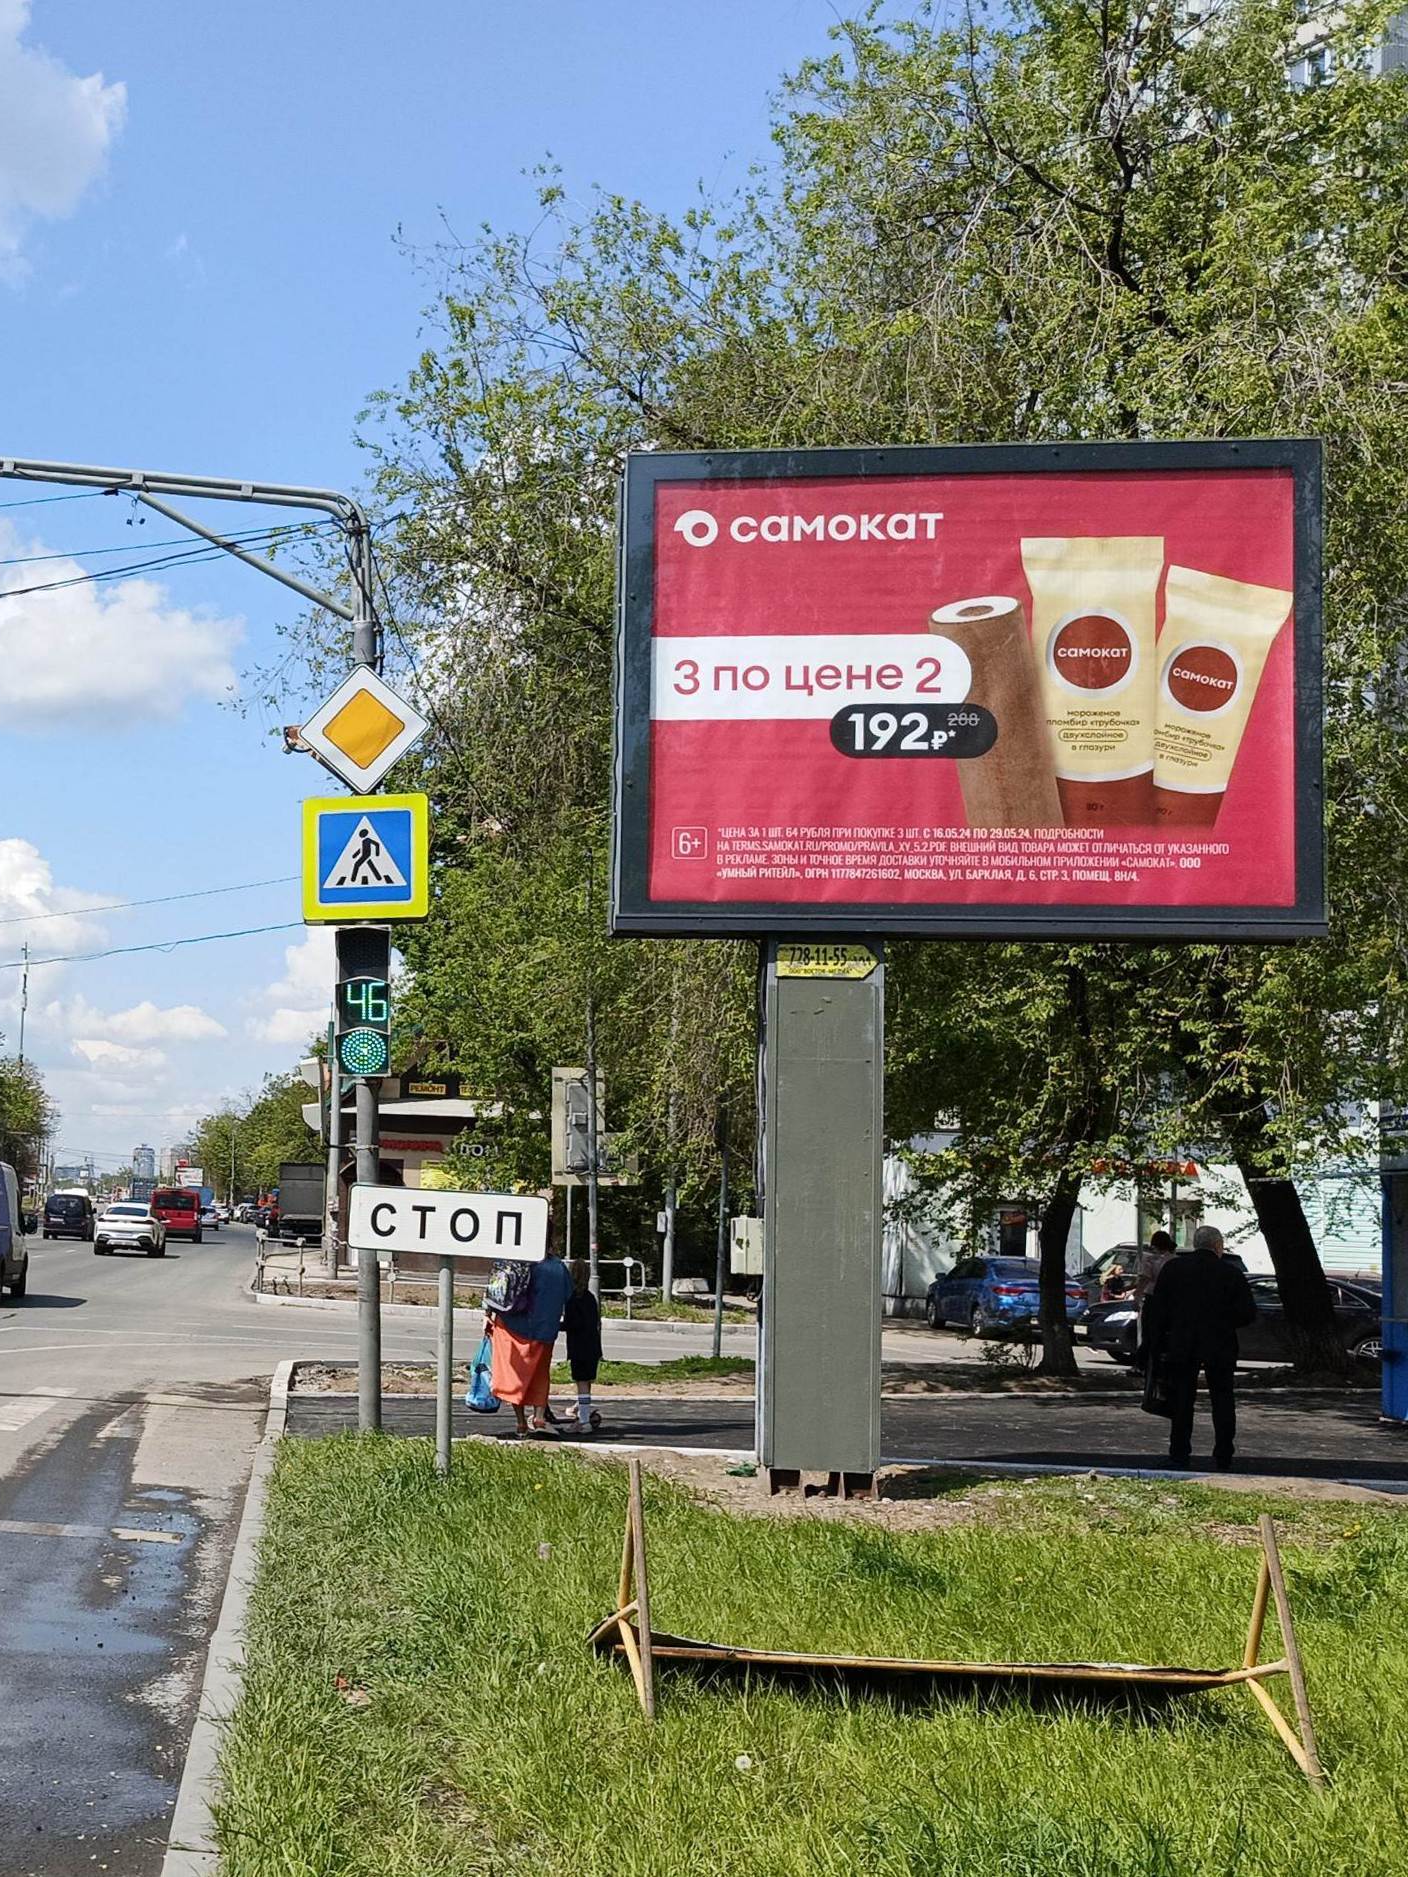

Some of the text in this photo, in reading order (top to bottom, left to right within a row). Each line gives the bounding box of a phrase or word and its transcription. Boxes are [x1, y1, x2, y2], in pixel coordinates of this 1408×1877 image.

[730, 512, 944, 543] самокат
[1057, 646, 1129, 659] самокат
[673, 657, 942, 697] 3 по цене 2
[1172, 667, 1235, 690] самокат
[1046, 718, 1088, 727] пломбир
[1067, 710, 1121, 719] мороженое
[1078, 744, 1116, 753] глазури
[747, 826, 760, 838] ЗА
[762, 826, 767, 838] 1
[768, 827, 783, 839] ШТ.
[785, 827, 799, 839] 64
[800, 827, 831, 839] РУБЛЯ
[832, 827, 852, 839] ПРИ
[853, 827, 896, 840] ПОКУПКЕ
[897, 828, 904, 839] 3
[923, 828, 931, 839] С
[933, 828, 971, 840] 16.05.24
[972, 828, 988, 840] ПО
[1033, 828, 1105, 841] ПОДРОБНОСТИ
[678, 831, 702, 855] 6+
[716, 841, 731, 852] НА
[950, 840, 997, 853] ВНЕШНИЙ
[998, 842, 1019, 854] ВИД
[1019, 842, 1055, 853] ТОВАРА
[1057, 842, 1090, 853] МОЖЕТ
[1092, 843, 1152, 855] ОТЛИЧАТЬСЯ
[1153, 843, 1166, 855] ОТ
[1167, 843, 1230, 856] УКАЗАННОГО
[716, 854, 724, 865] В
[725, 854, 769, 865] РЕКЛАМЕ.
[771, 854, 798, 865] ЗОНЫ
[800, 854, 807, 865] И
[809, 854, 844, 866] ТОЧНОЕ
[845, 854, 877, 866] ВРЕМЯ
[878, 855, 927, 867] ДОСТАВКИ
[928, 853, 981, 867] УТОЧНЯЙТЕ
[982, 855, 989, 866] В
[990, 855, 1051, 867] МОБИЛЬНОМ
[1053, 856, 1120, 868] ПРИЛОЖЕНИИ
[1179, 857, 1201, 868] ООО
[716, 866, 757, 879] «УМНЫЙ
[805, 868, 829, 879] ОГРН
[904, 868, 945, 880] МОСКВА,
[948, 869, 963, 881] УЛ.
[965, 869, 1013, 882] БАРКЛАЯ,
[1015, 870, 1027, 882] Д.
[1040, 870, 1060, 881] СТР.
[1072, 870, 1112, 883] ПОМЕЩ.
[346, 982, 388, 1021] 46
[370, 1202, 523, 1247] СТОП
